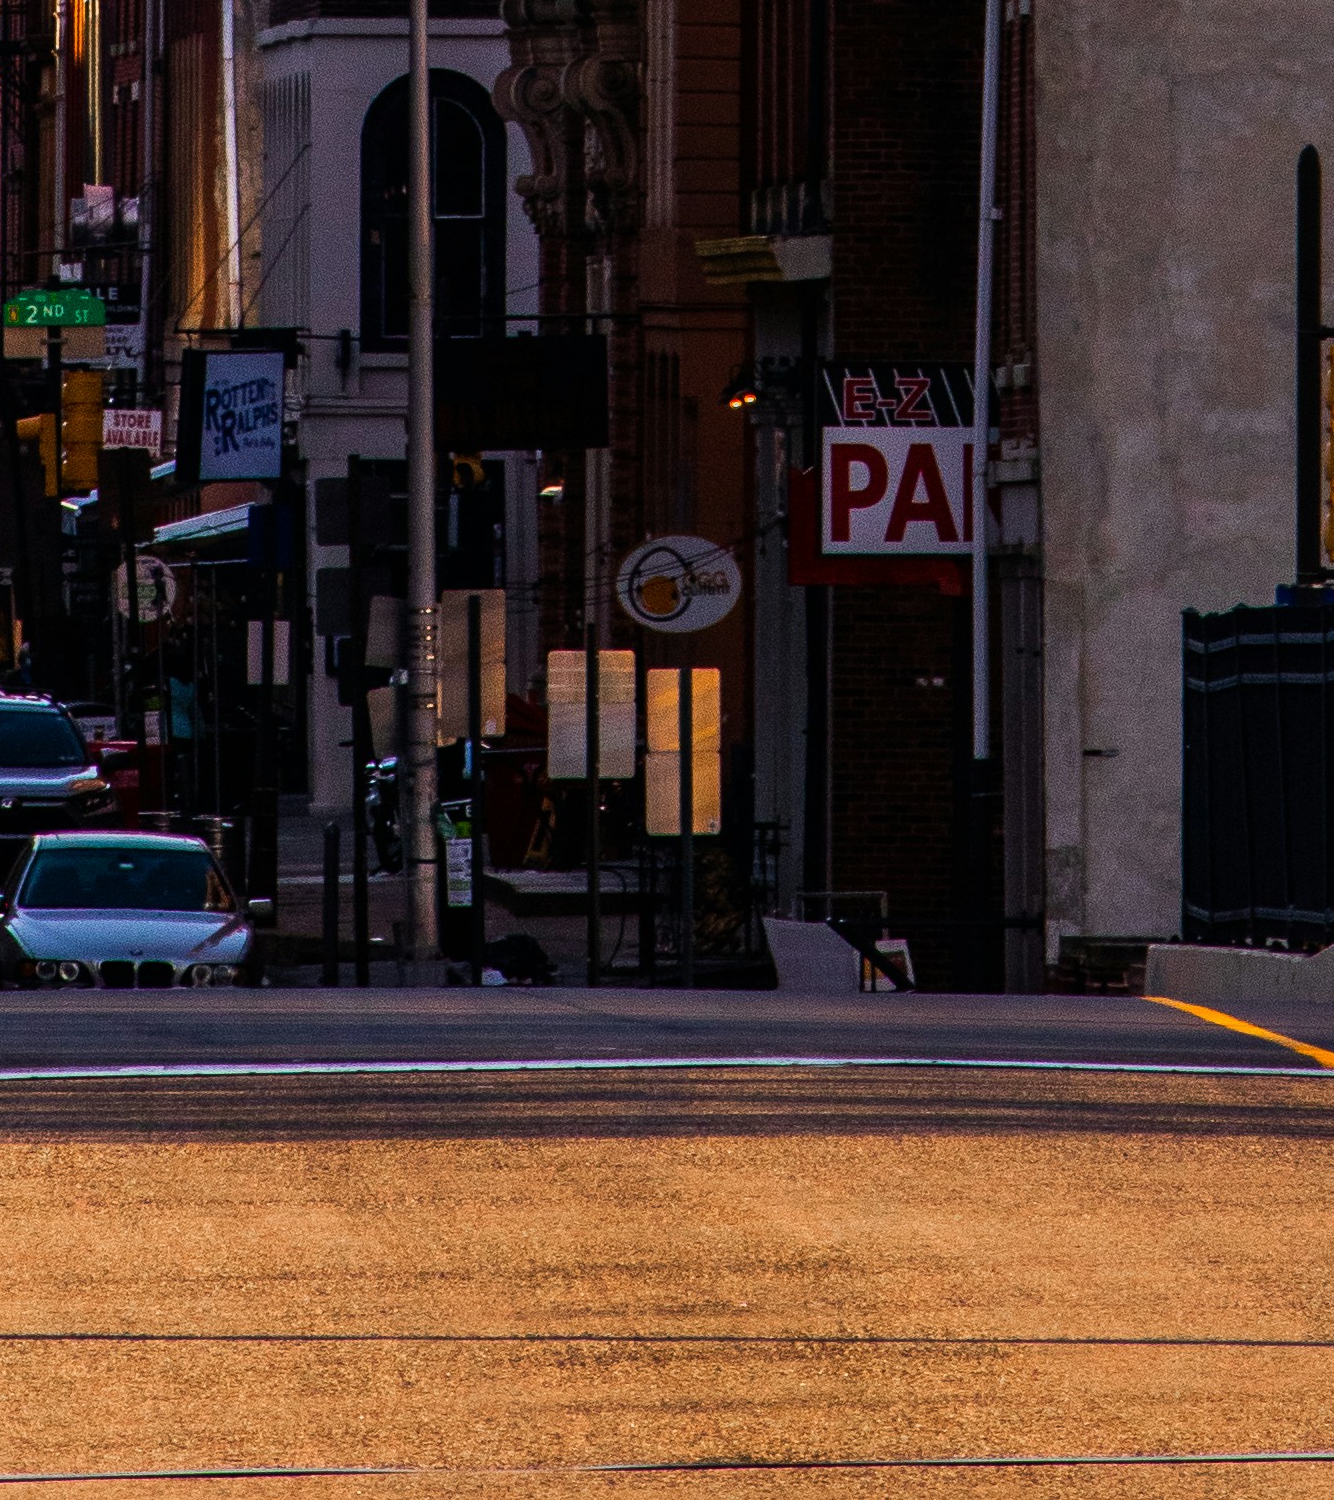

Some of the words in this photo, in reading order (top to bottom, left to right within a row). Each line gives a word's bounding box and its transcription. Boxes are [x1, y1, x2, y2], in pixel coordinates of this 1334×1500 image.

[26, 304, 64, 323] 2ND
[75, 309, 88, 323] ST
[205, 377, 270, 432] ROTTEN
[843, 377, 932, 421] E-Z
[114, 414, 150, 428] STORE
[106, 431, 158, 446] AVAILABLE
